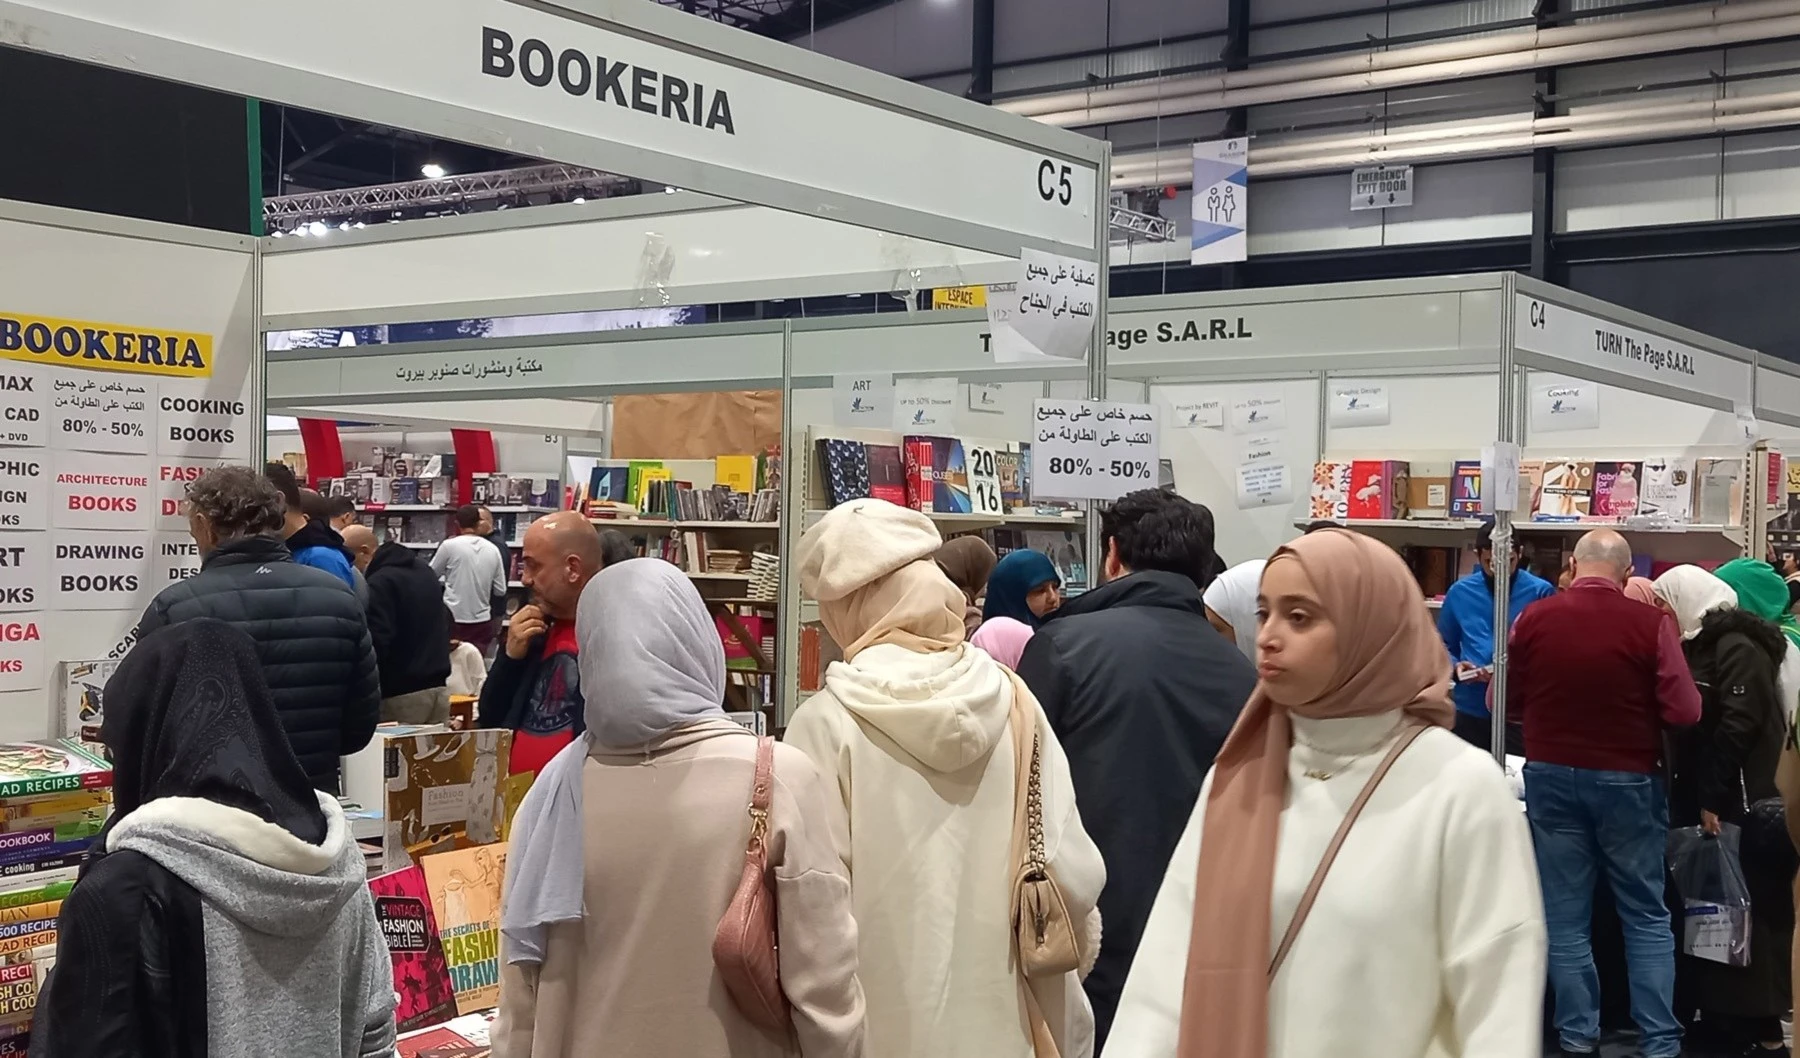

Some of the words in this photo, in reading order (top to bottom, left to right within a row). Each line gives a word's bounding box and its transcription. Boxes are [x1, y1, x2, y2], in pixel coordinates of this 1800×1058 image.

[481, 25, 735, 136] BOOKERIA
[1037, 158, 1072, 206] C5
[1357, 169, 1406, 183] EMERGENCY
[1357, 182, 1378, 195] EXIT
[1379, 179, 1406, 193] DOOR
[1026, 262, 1049, 281] جميع
[1050, 264, 1067, 285] على
[1070, 265, 1095, 286] تصفية
[948, 289, 973, 305] ESPACE
[1019, 292, 1051, 314] الجناح
[1052, 295, 1068, 320] في
[1069, 301, 1093, 320] الكتب
[1530, 301, 1545, 329] C4
[1107, 327, 1148, 350] age
[1156, 317, 1253, 343] S.A.R.L
[0, 318, 206, 369] BOOKERIA
[1595, 329, 1622, 356] TURN
[1625, 337, 1642, 361] The
[1643, 343, 1666, 370] Page
[1666, 350, 1695, 376] S.A.R.L
[396, 367, 424, 381] بيروت
[427, 363, 459, 381] صنوبر
[461, 359, 513, 378] ومنشورات
[516, 356, 543, 376] مكتبة
[54, 379, 77, 391] جميع
[79, 379, 96, 392] على
[100, 382, 123, 393] خاص
[125, 386, 146, 396] حسم
[852, 380, 872, 391] ART
[55, 396, 68, 407] من
[70, 395, 100, 409] الطاولة
[102, 399, 119, 412] على
[123, 401, 145, 412] الكتب
[160, 396, 245, 416] COOKING
[5, 407, 40, 421] CAD
[1036, 406, 1066, 421] جميع
[1069, 405, 1092, 421] على
[1096, 407, 1126, 421] خاص
[1128, 412, 1153, 425] حسم
[62, 419, 97, 434] 80%
[111, 421, 144, 437] 50%
[169, 426, 235, 443] BOOKS
[1038, 428, 1055, 442] من
[1059, 425, 1097, 443] الطاولة
[8, 433, 28, 441] DVD
[1100, 430, 1121, 447] على
[1125, 432, 1152, 446] الكتب
[971, 448, 995, 478] 20
[1049, 457, 1093, 476] 80%
[1109, 460, 1151, 479] 50%
[57, 474, 148, 487] ARCHITECTURE
[68, 495, 137, 512] BOOKS
[976, 482, 998, 511] 16
[56, 545, 144, 560] DRAWING
[161, 543, 198, 556] INTE
[168, 567, 199, 580] DES
[60, 574, 139, 592] BOOKS
[1, 783, 20, 796] AD
[26, 776, 80, 793] RECIPES
[4, 862, 35, 875] cooking
[386, 904, 422, 917] VINTAGE
[20, 918, 57, 934] RECIPE
[383, 918, 425, 934] FASHION
[440, 929, 451, 939] THE
[453, 922, 481, 937] SECRETS
[482, 920, 490, 930] OF
[386, 934, 408, 948] BIBLE
[442, 927, 499, 967] FASHI
[448, 957, 499, 993] DRAW
